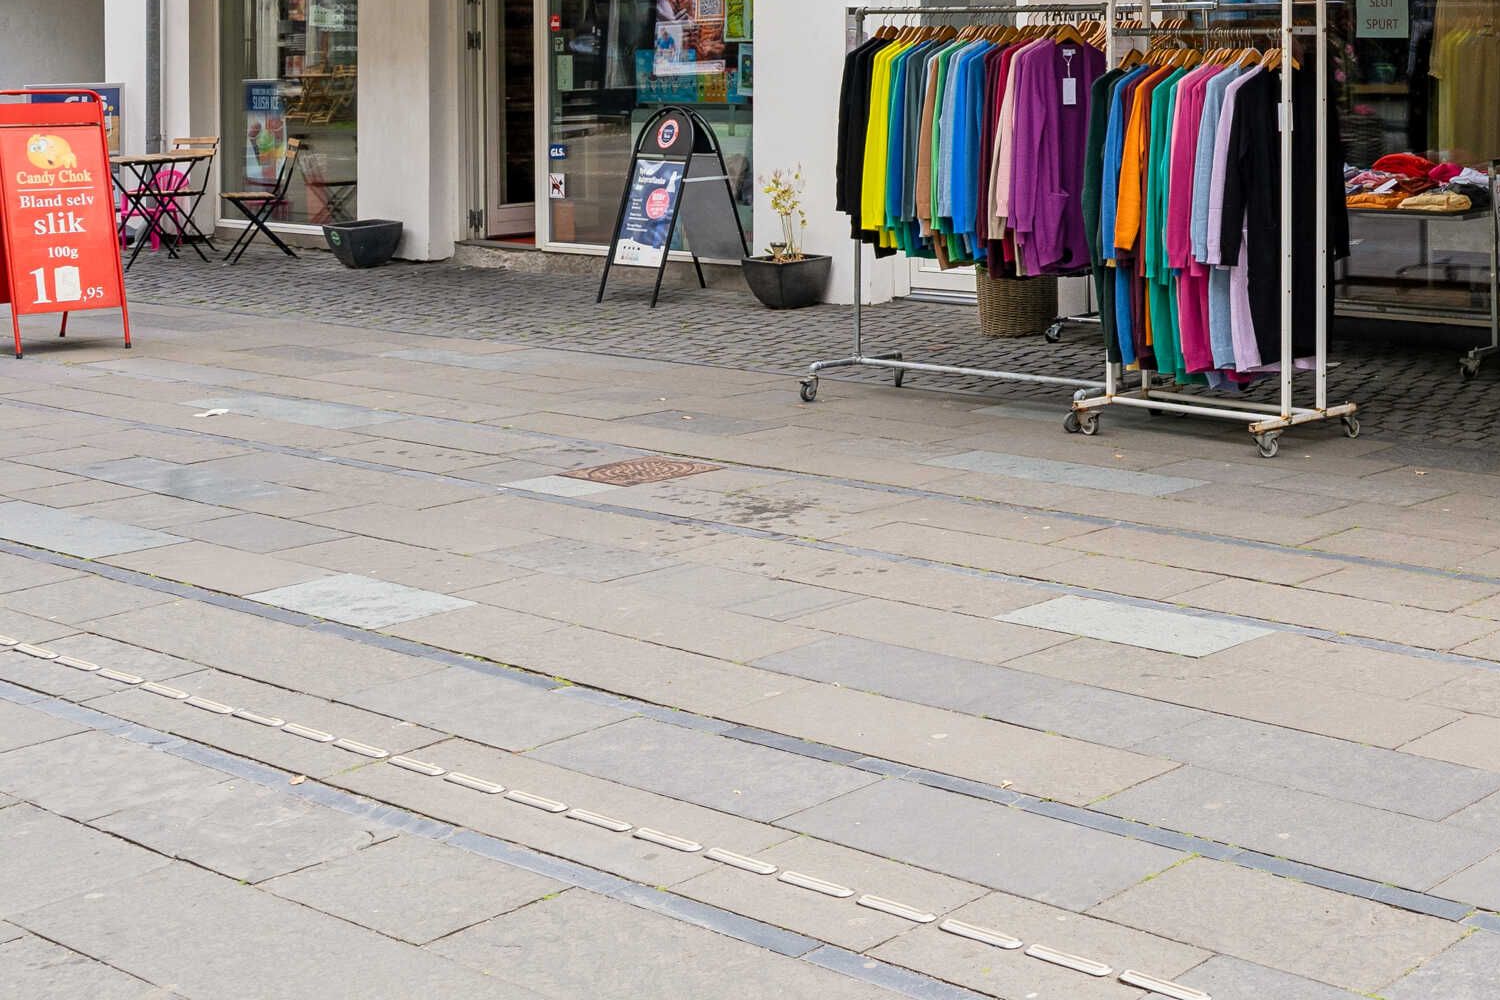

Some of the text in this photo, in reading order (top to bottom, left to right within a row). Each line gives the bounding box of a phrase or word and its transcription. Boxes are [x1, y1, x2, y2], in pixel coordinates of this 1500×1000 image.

[1366, 18, 1399, 30] SPURT
[16, 169, 92, 186] Candy Chok
[19, 193, 95, 209] Bland selv
[33, 211, 87, 235] slik
[48, 246, 79, 259] 100g
